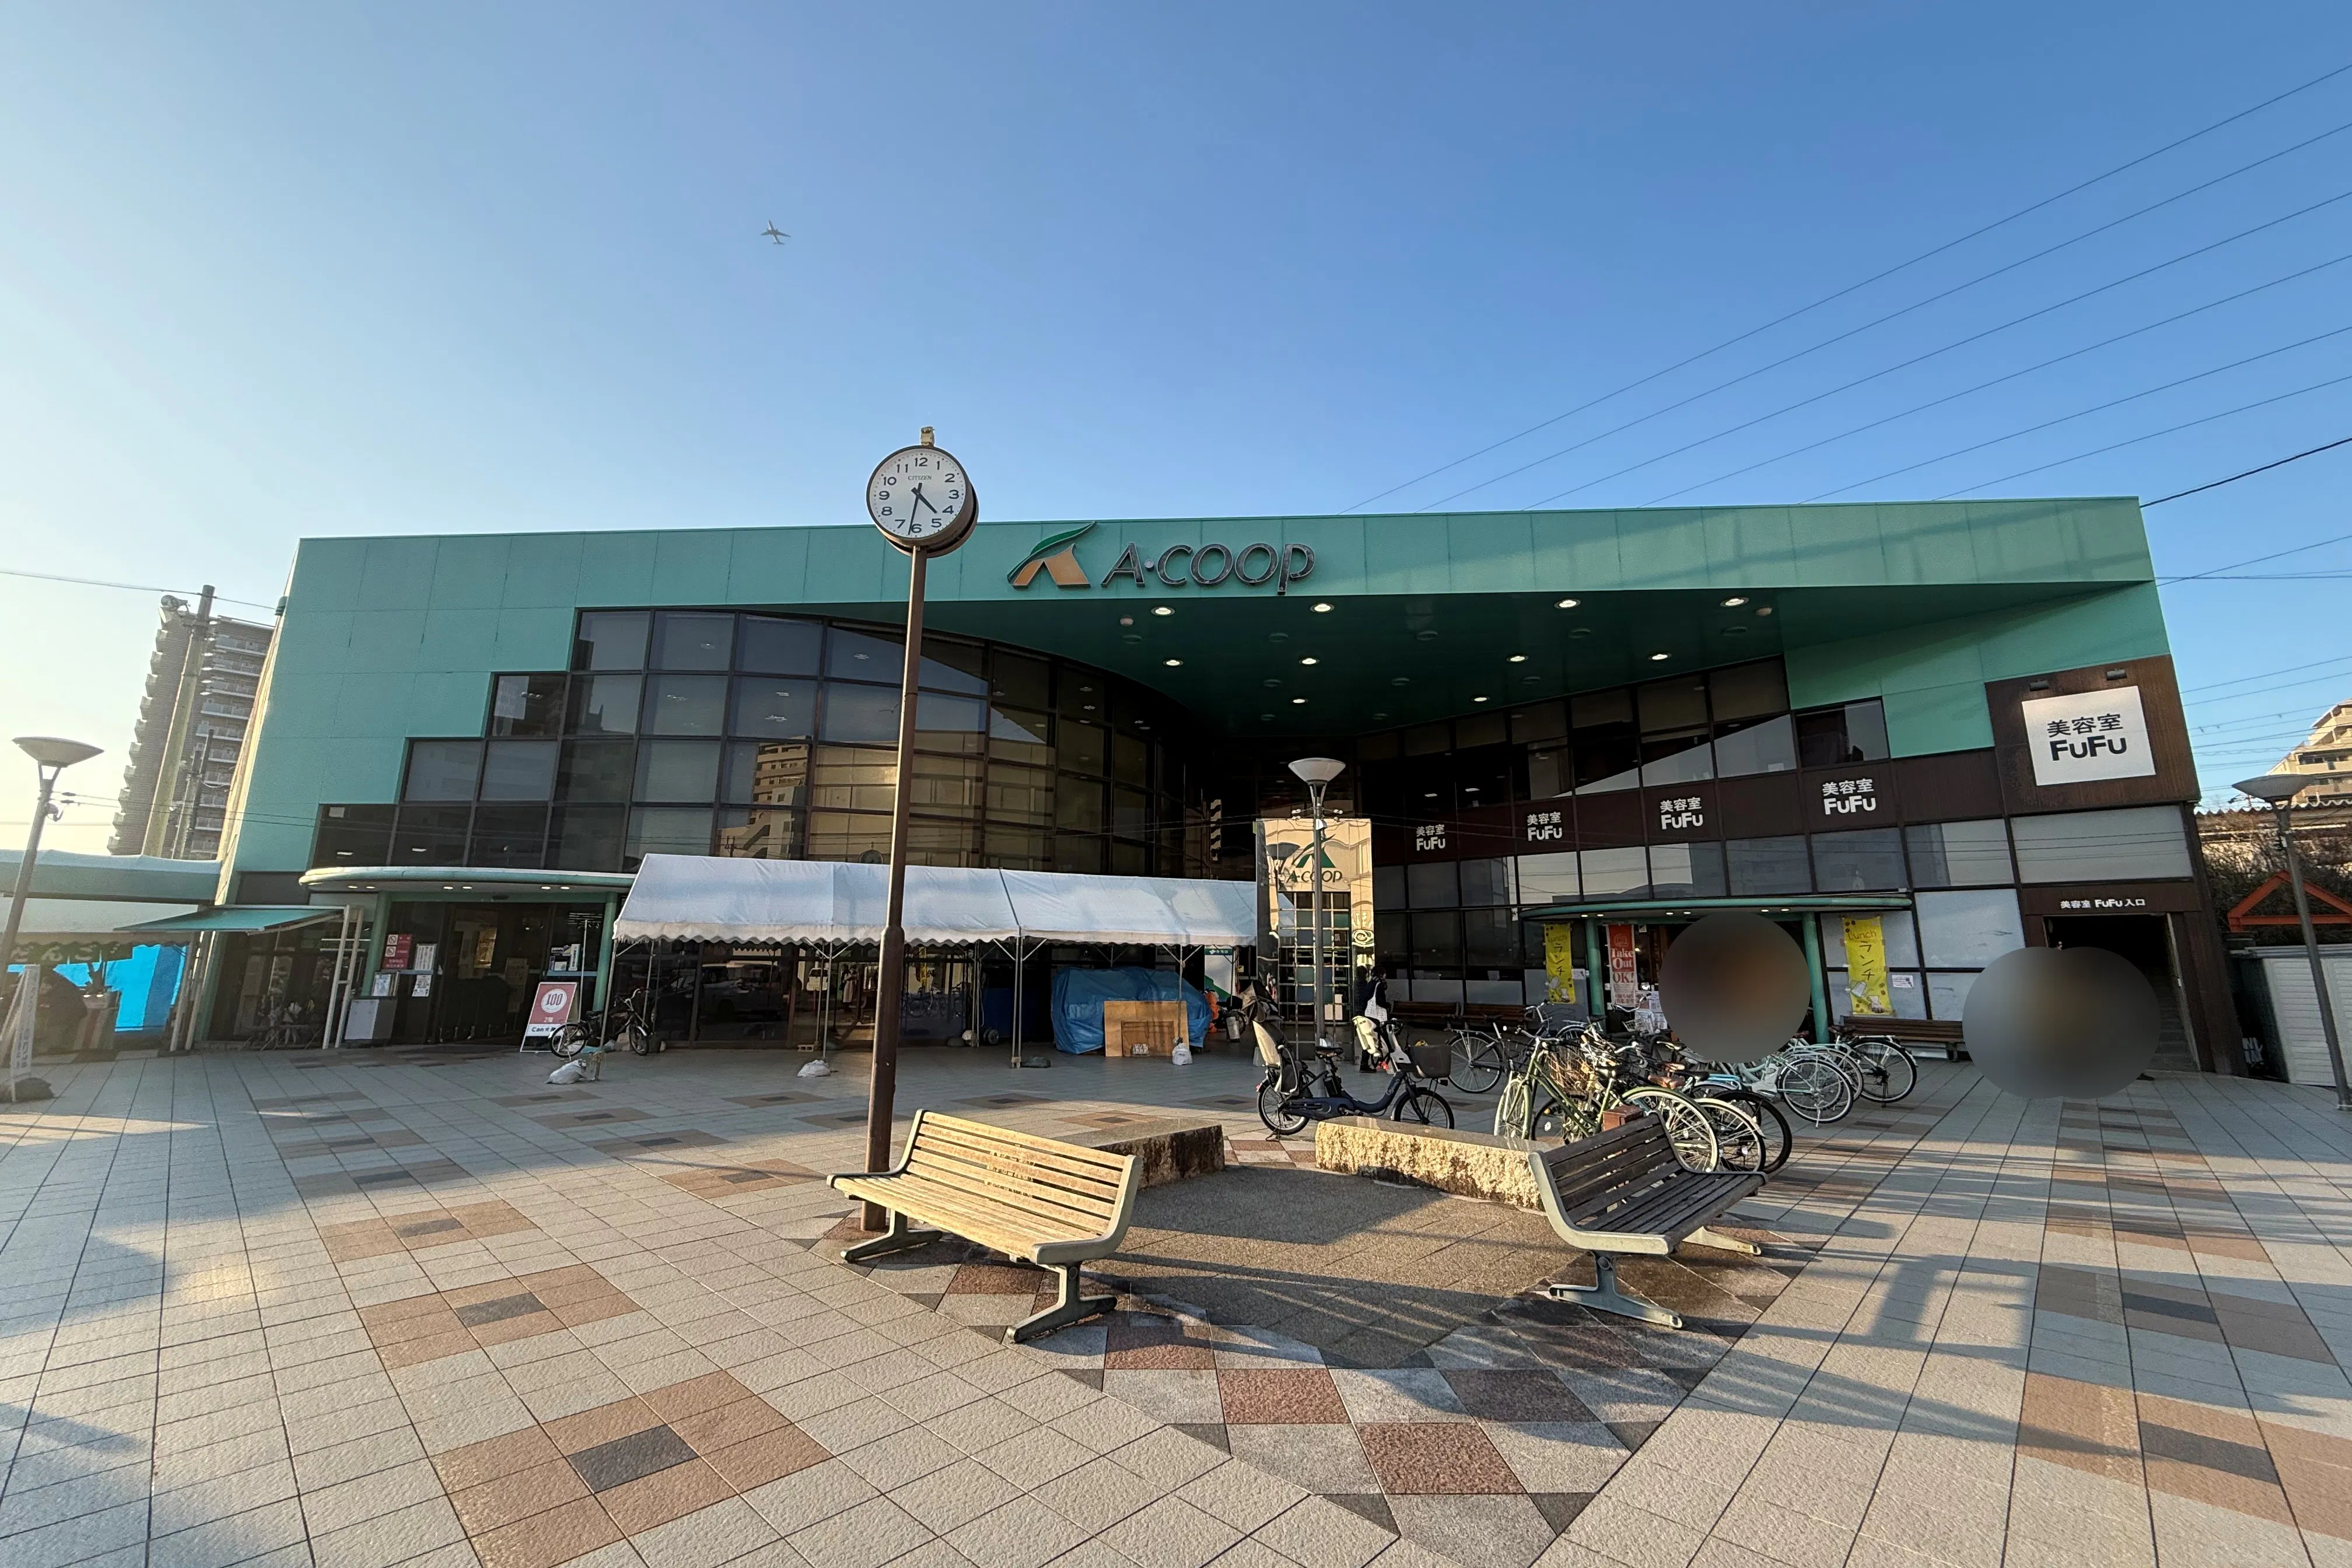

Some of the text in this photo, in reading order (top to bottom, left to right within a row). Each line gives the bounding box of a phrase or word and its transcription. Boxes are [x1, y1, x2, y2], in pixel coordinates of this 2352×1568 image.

[914, 457, 928, 467] 12
[936, 460, 940, 470] 1
[897, 464, 908, 473] 11
[883, 476, 897, 486] 10
[944, 473, 956, 483] 2
[879, 491, 890, 501] 9
[949, 489, 960, 499] 3
[881, 506, 892, 516] 8
[942, 505, 954, 514] 4
[895, 519, 906, 528] 7
[931, 518, 942, 528] 5
[912, 524, 922, 533] 6
[2047, 713, 2123, 738] 美容室
[1822, 778, 1874, 796] 美容室
[1660, 797, 1702, 813] 美容室
[1527, 811, 1562, 826] 美容室
[1416, 824, 1445, 837] 美容室
[2060, 900, 2091, 909] 美容室
[2124, 899, 2146, 907] 入口
[1848, 930, 1877, 940] Lunch
[1611, 948, 1634, 958] Take
[1554, 943, 1566, 976] ランチ
[1612, 958, 1633, 969] Out
[1859, 940, 1875, 981] ランチ
[1613, 972, 1634, 983] OK!
[545, 993, 563, 1006] 100
